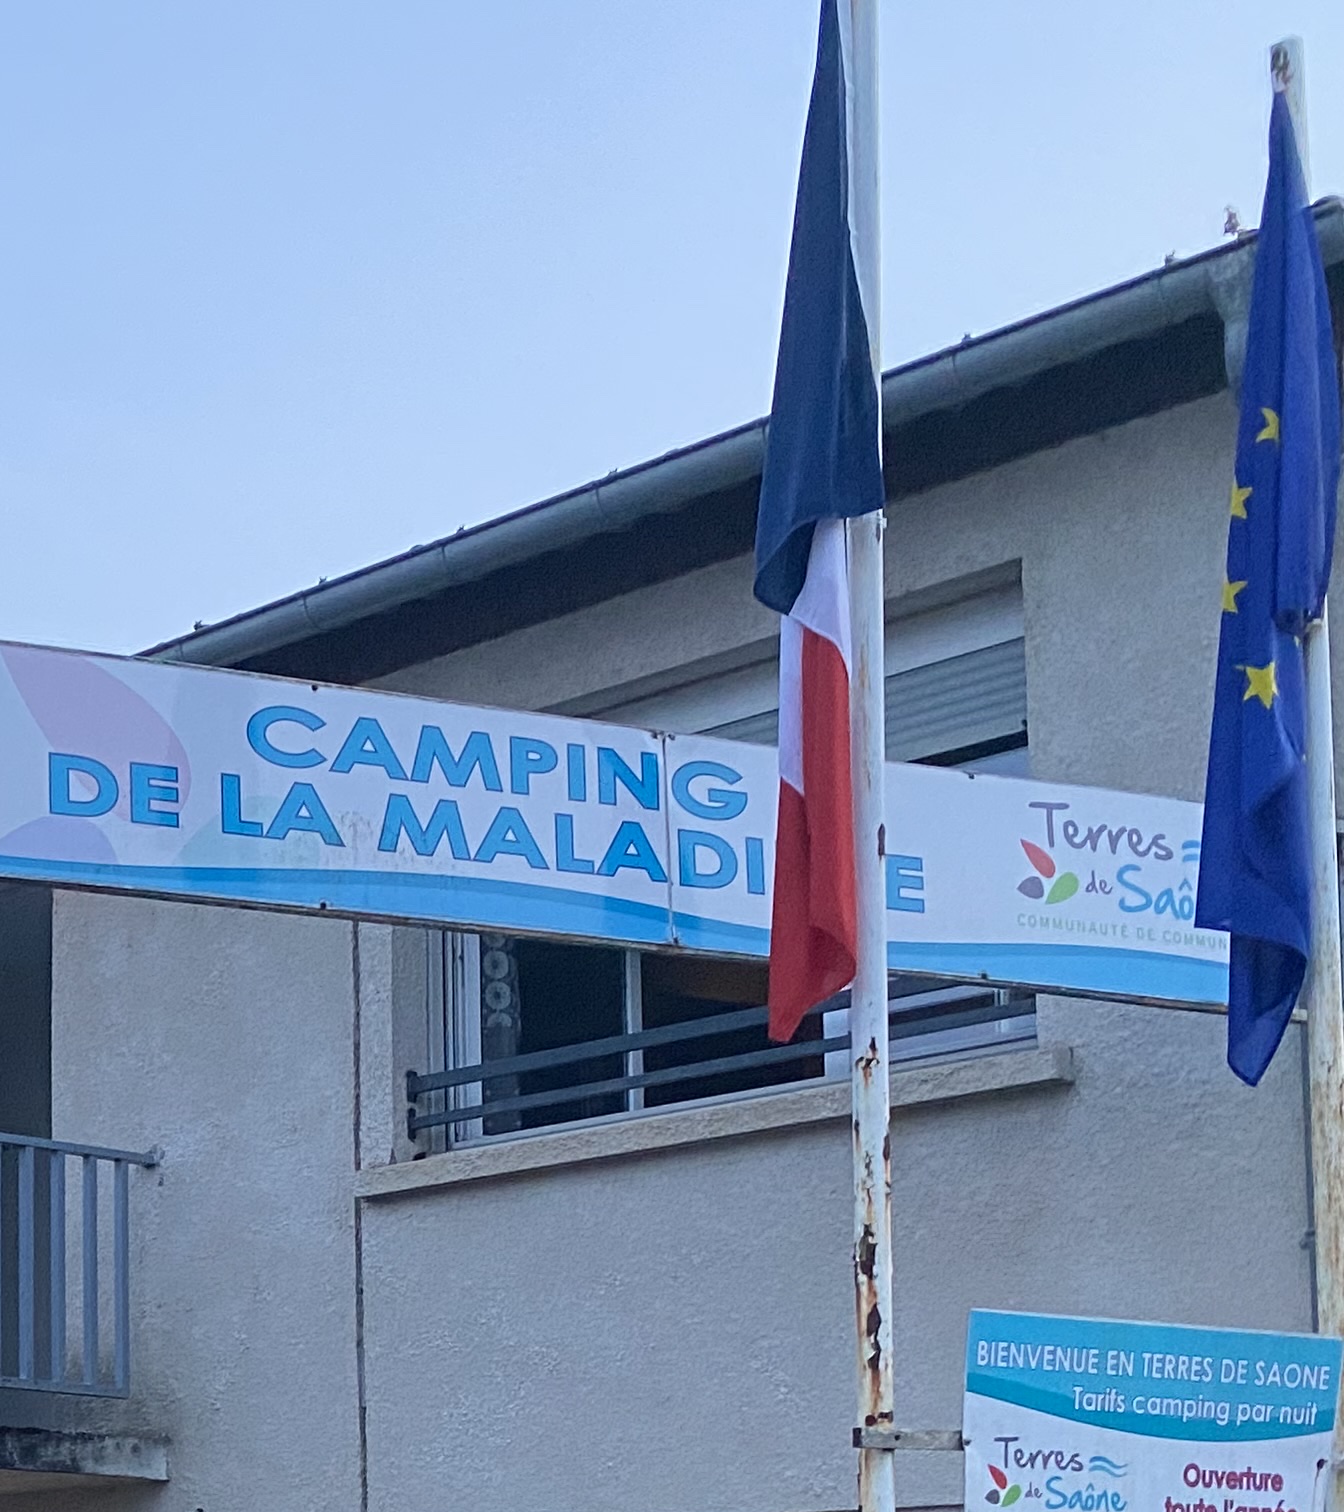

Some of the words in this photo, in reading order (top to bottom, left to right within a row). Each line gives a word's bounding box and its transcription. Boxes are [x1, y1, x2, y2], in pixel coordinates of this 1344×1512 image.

[246, 706, 747, 820] CAMPING
[48, 752, 179, 827] DE
[220, 773, 345, 846] LA
[378, 794, 925, 913] MALADIE
[1029, 801, 1174, 861] Terres
[1085, 870, 1113, 894] de
[1116, 864, 1195, 921] Saô
[1017, 913, 1128, 939] COMMUNAUTÉ
[1137, 927, 1156, 941] DE
[1162, 930, 1227, 951] COMMUN
[976, 1340, 1098, 1375] BIENVENUE
[1106, 1350, 1134, 1377] EN
[1142, 1352, 1213, 1384] TERRES
[1220, 1359, 1248, 1386] DE
[1254, 1361, 1330, 1391] SAONE
[1072, 1386, 1126, 1414] Tarifs
[1132, 1394, 1229, 1426] camping
[1236, 1403, 1275, 1427] par
[1279, 1400, 1318, 1426] nuit
[994, 1436, 1084, 1473] Terres
[1024, 1481, 1043, 1499] de
[1045, 1476, 1128, 1512] Saône
[1183, 1463, 1284, 1493] Ouverture
